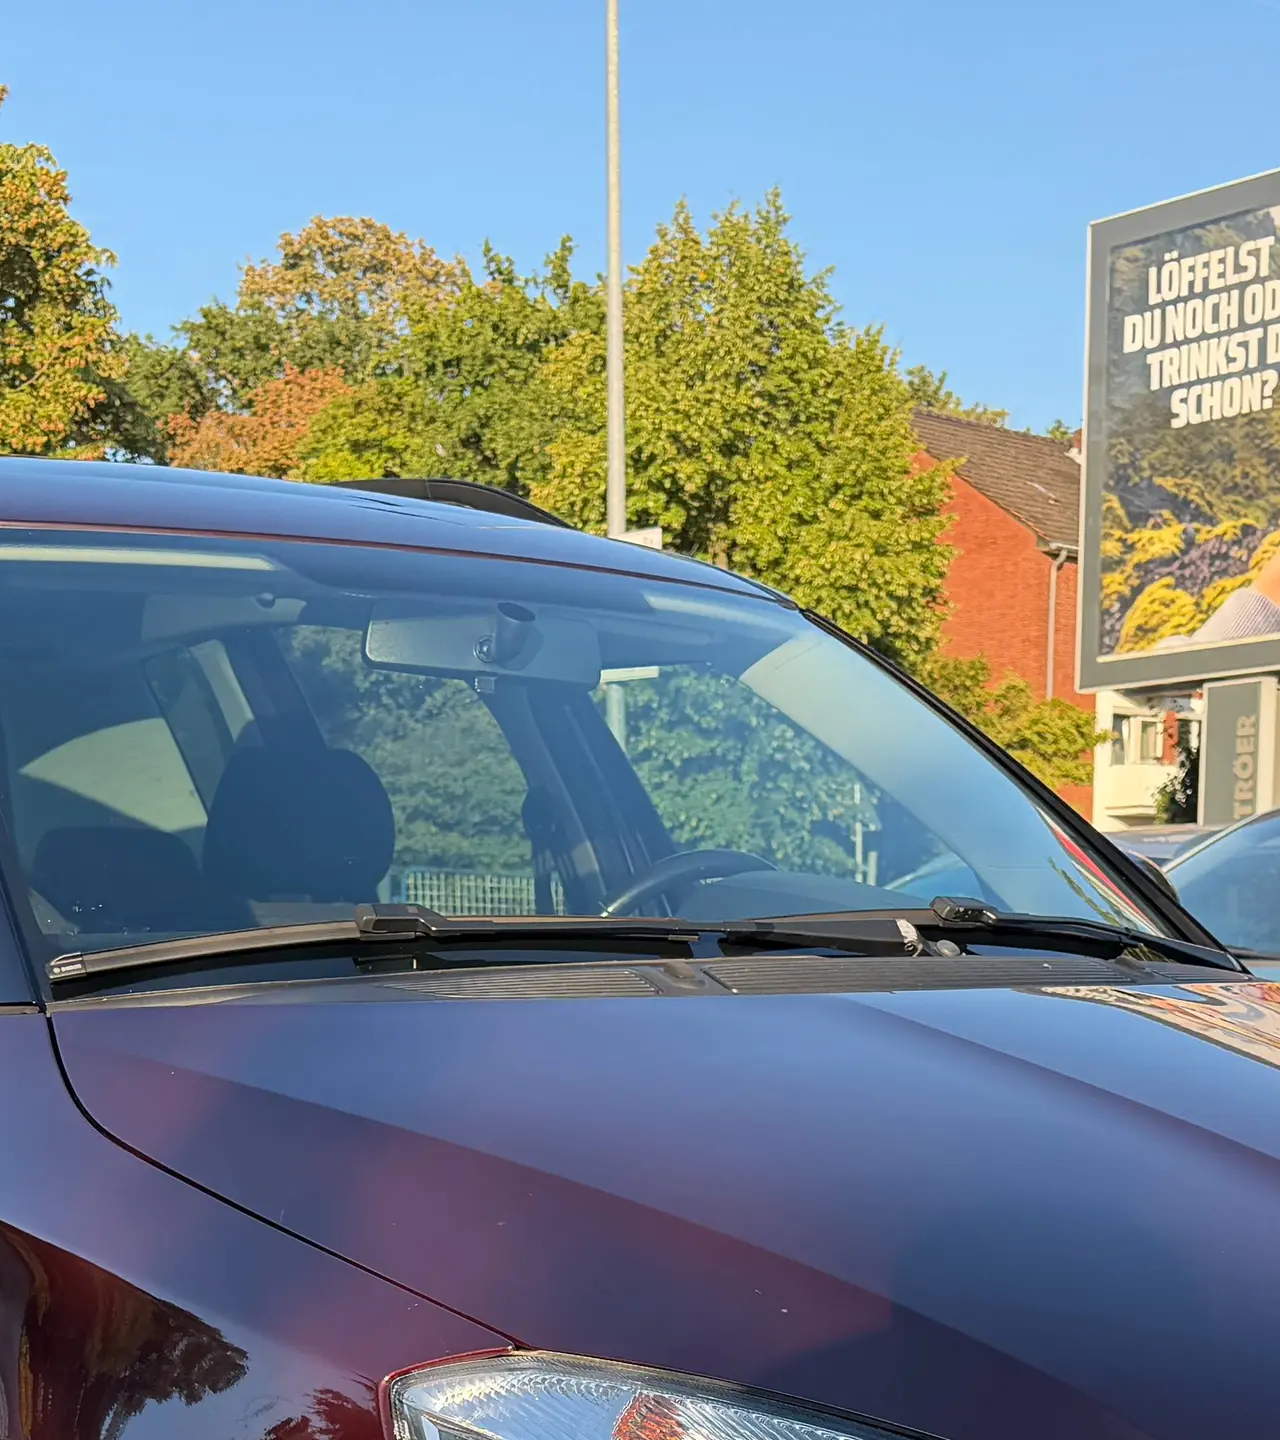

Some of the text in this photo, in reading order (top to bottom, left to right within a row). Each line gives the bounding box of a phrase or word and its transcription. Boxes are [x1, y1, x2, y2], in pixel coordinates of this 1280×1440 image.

[1148, 236, 1275, 306] LÖFFELST
[1123, 309, 1162, 353] DU
[1165, 289, 1239, 344] NOCH
[1146, 327, 1264, 391] TRINKST
[1170, 368, 1279, 429] SCHON?
